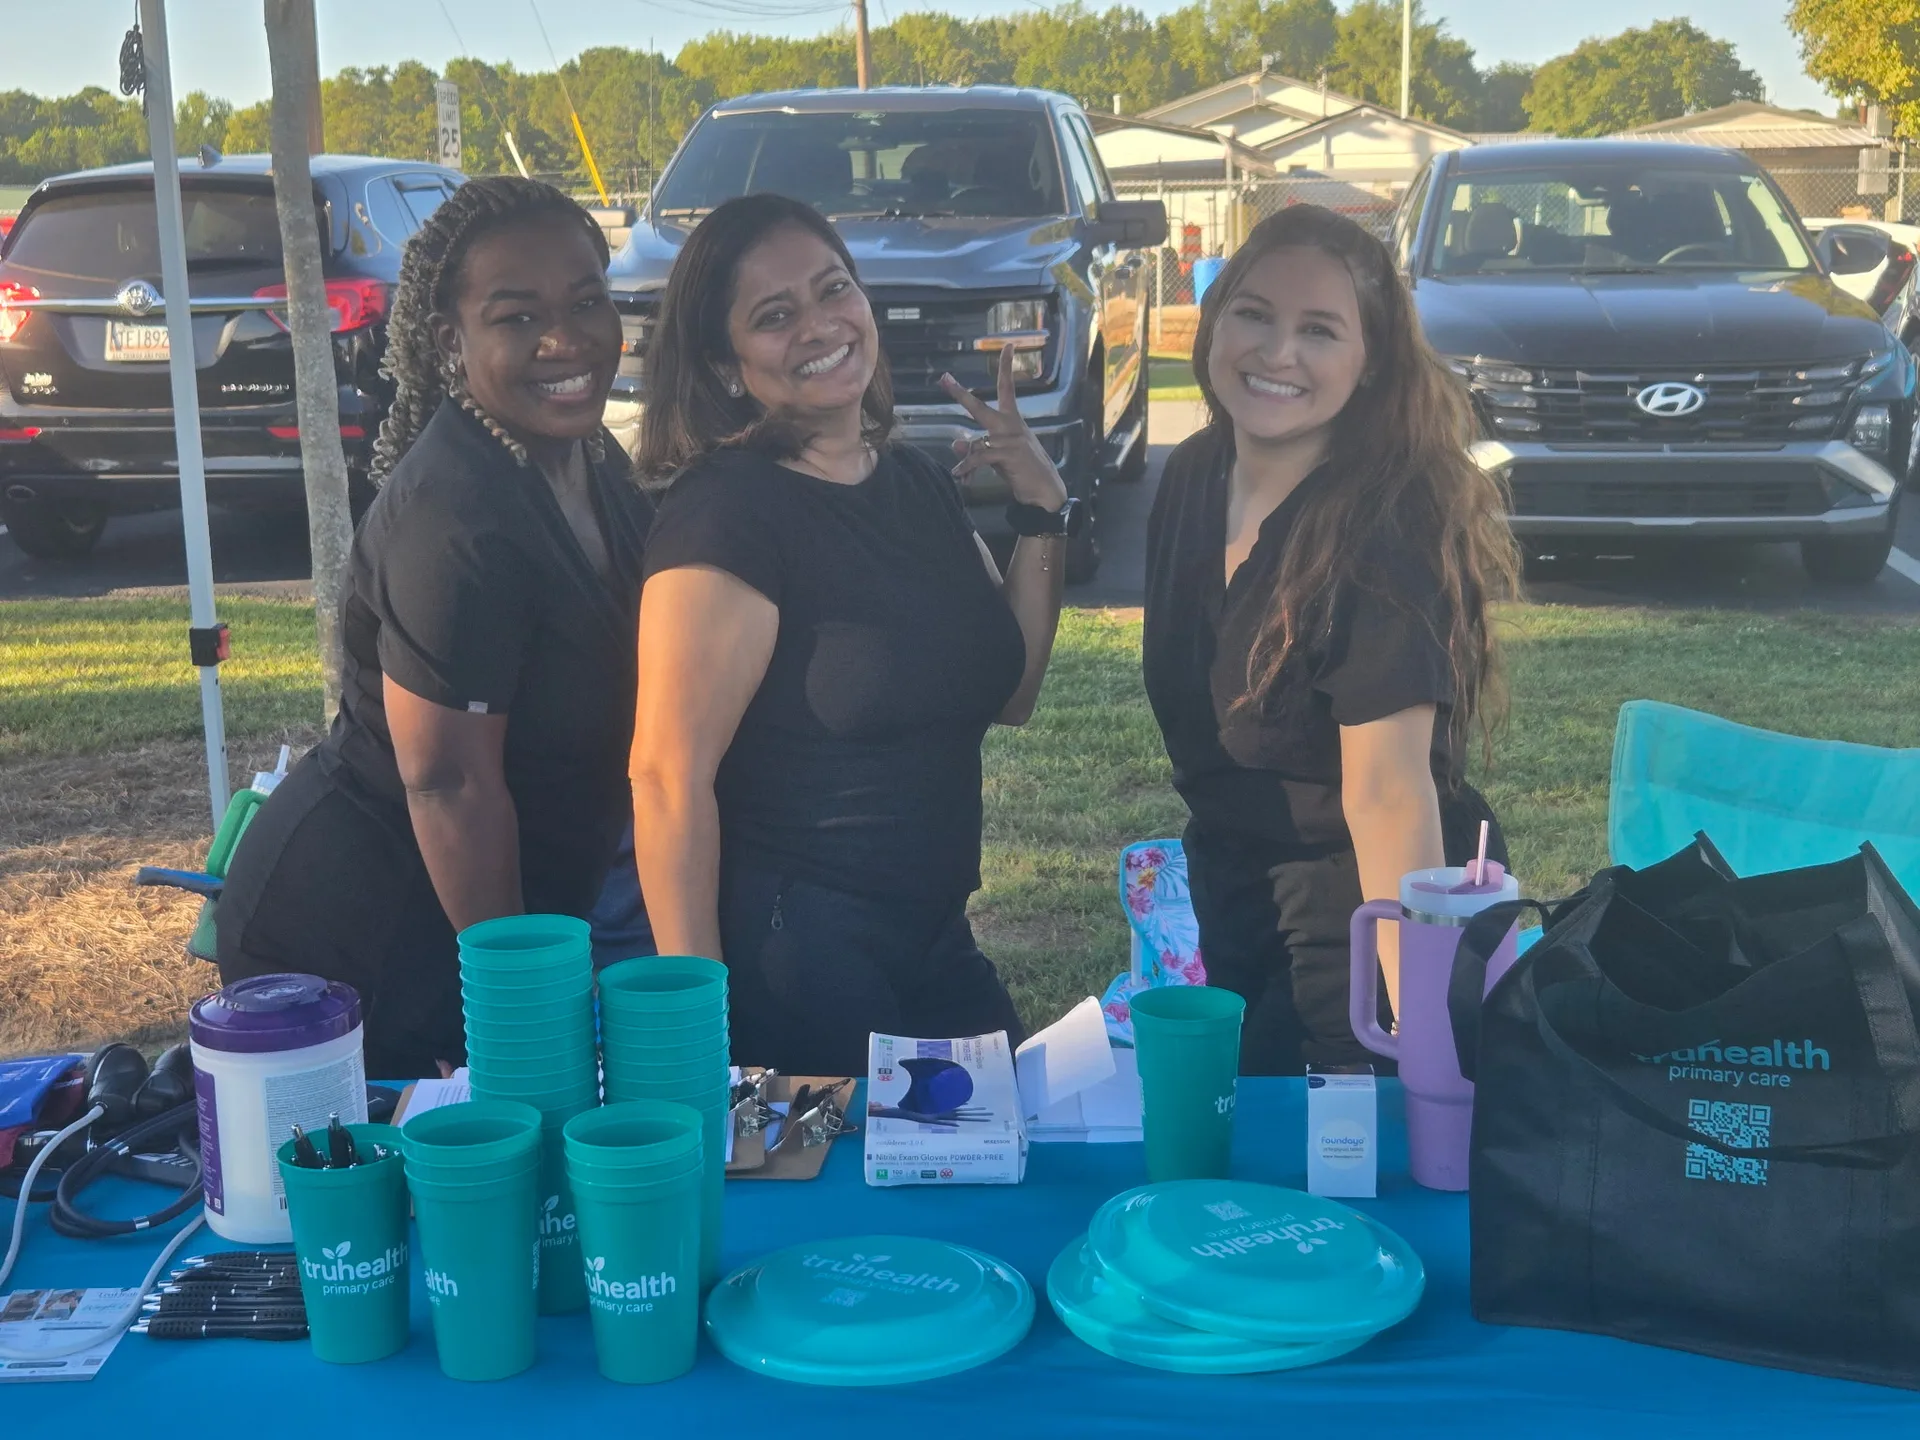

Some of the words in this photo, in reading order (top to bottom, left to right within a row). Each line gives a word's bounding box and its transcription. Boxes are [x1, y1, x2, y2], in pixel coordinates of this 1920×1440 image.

[442, 127, 460, 158] 25
[1669, 1063, 1744, 1088] primary
[1748, 1071, 1791, 1087] care
[950, 1153, 1004, 1161] POWDER-FREE
[1190, 1217, 1346, 1259] truhealth
[302, 1241, 408, 1281] truhealth
[803, 1254, 960, 1293] truhealth
[323, 1282, 369, 1296] primary
[372, 1274, 395, 1290] care
[626, 1302, 653, 1313] care
